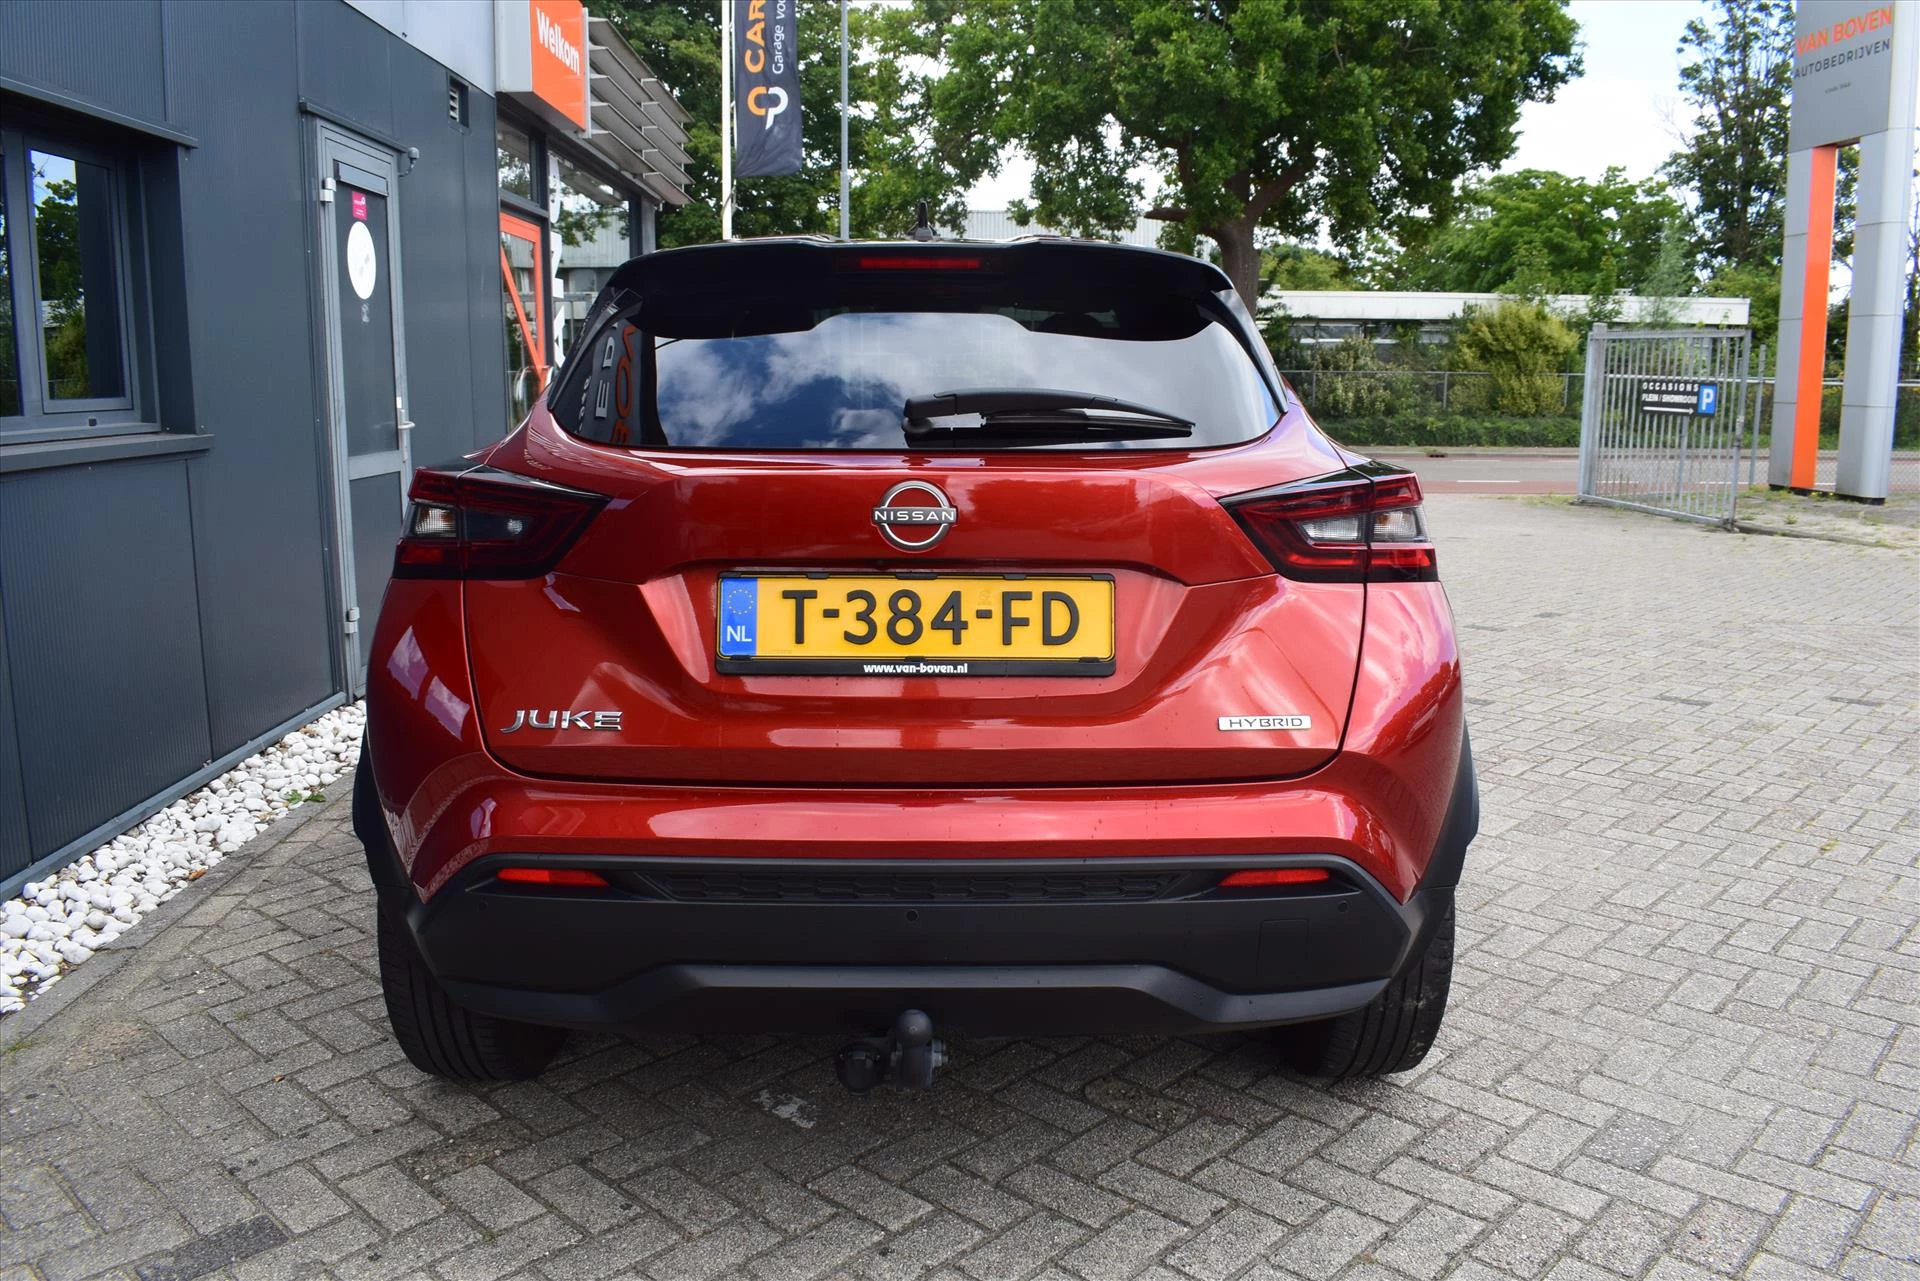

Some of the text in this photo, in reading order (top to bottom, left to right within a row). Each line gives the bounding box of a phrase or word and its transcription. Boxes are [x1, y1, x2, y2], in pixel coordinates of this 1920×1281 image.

[536, 7, 581, 75] Welkom
[1795, 5, 1893, 56] VAN BOVEN
[772, 25, 785, 74] Garage
[1794, 39, 1891, 78] AUTOBEDRIJVEN
[1642, 382, 1699, 392] OCCASIONS
[1702, 388, 1714, 411] P
[874, 510, 955, 522] NISSAN
[782, 589, 1080, 646] T-384-FD
[726, 625, 752, 643] NL
[863, 662, 968, 674] www.van-boven.nl
[500, 709, 623, 734] JUKE
[1229, 718, 1303, 728] HYBRID
